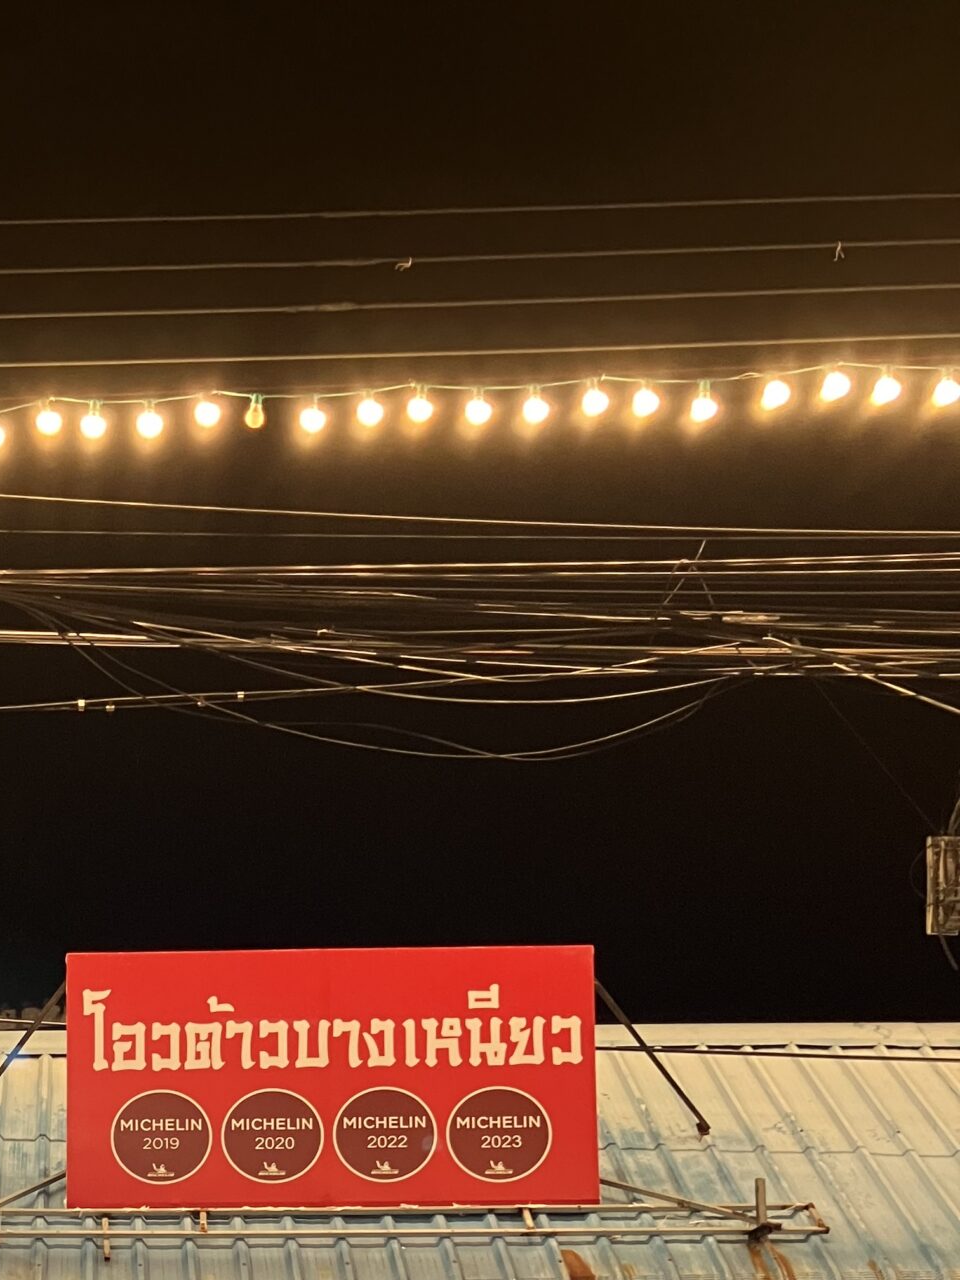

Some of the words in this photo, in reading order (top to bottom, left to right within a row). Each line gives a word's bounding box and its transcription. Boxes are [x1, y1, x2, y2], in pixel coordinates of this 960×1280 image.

[83, 984, 583, 1071] โอวต้าวบางเหนียว
[120, 1118, 202, 1131] MICHELIN
[231, 1118, 313, 1131] MICHELIN
[343, 1116, 427, 1129] MICHELIN
[456, 1116, 541, 1129] MICHELIN
[143, 1137, 180, 1150] 2019
[255, 1137, 295, 1150] 2020
[367, 1135, 408, 1148] 2022
[481, 1135, 522, 1148] 2023
